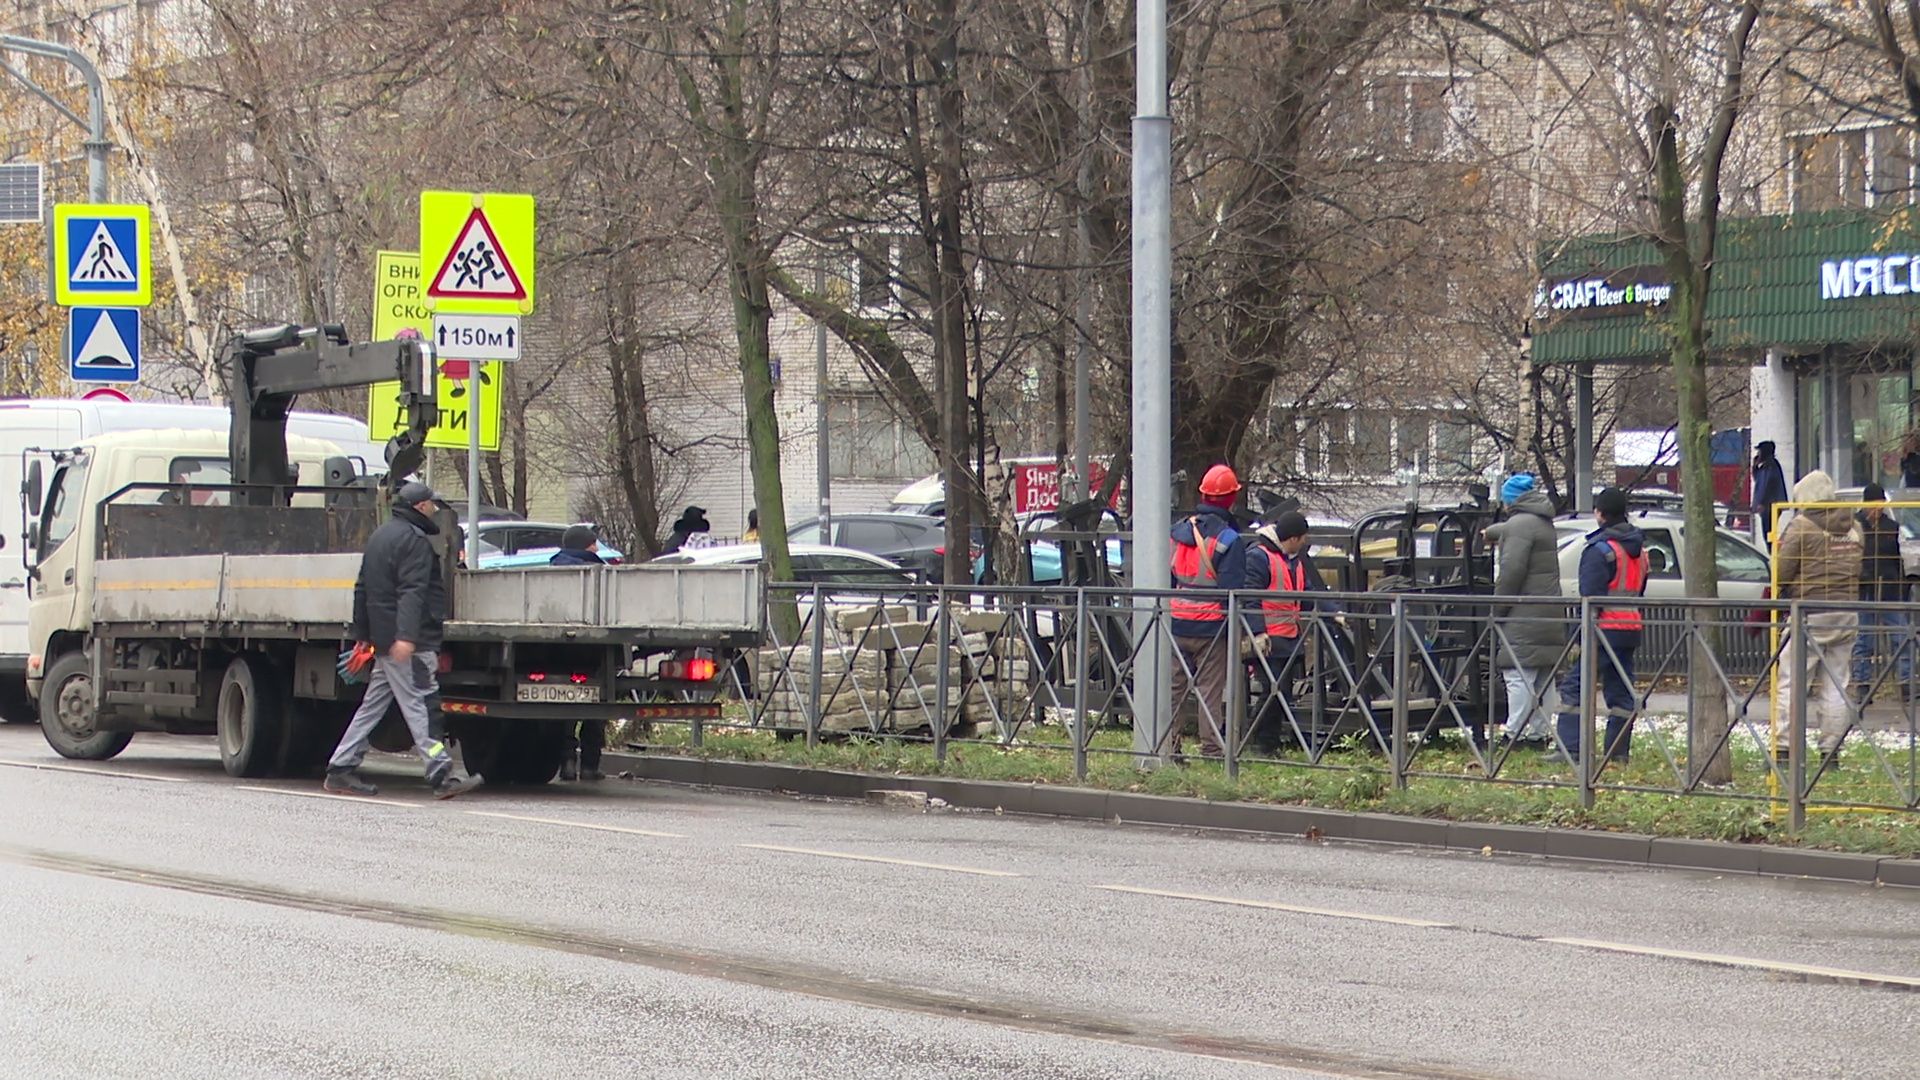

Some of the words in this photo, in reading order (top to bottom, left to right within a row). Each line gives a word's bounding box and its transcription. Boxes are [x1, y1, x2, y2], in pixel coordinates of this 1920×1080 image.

[383, 283, 420, 299] ОГР
[1634, 283, 1671, 307] Burger
[393, 406, 467, 430] ДТИ
